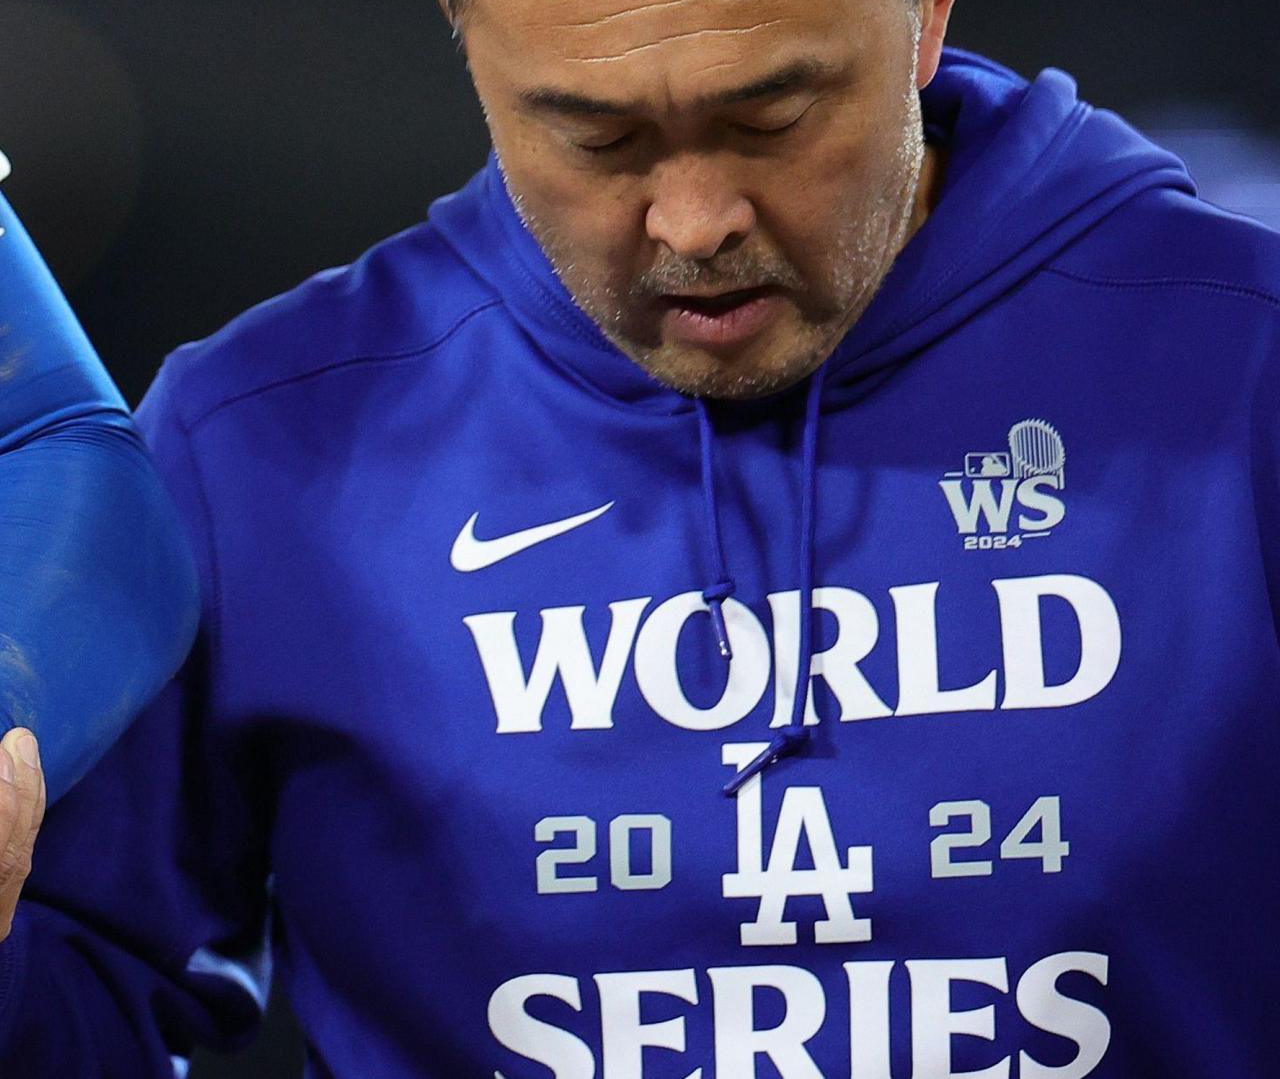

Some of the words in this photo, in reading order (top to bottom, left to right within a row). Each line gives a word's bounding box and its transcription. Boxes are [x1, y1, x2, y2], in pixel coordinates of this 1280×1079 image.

[938, 474, 1066, 534] WS
[963, 534, 1023, 550] 2024
[462, 573, 1122, 734] WORLD
[534, 813, 672, 894] 20
[722, 742, 874, 946] LA
[929, 796, 1070, 879] 24
[487, 951, 1112, 1079] SERIES
